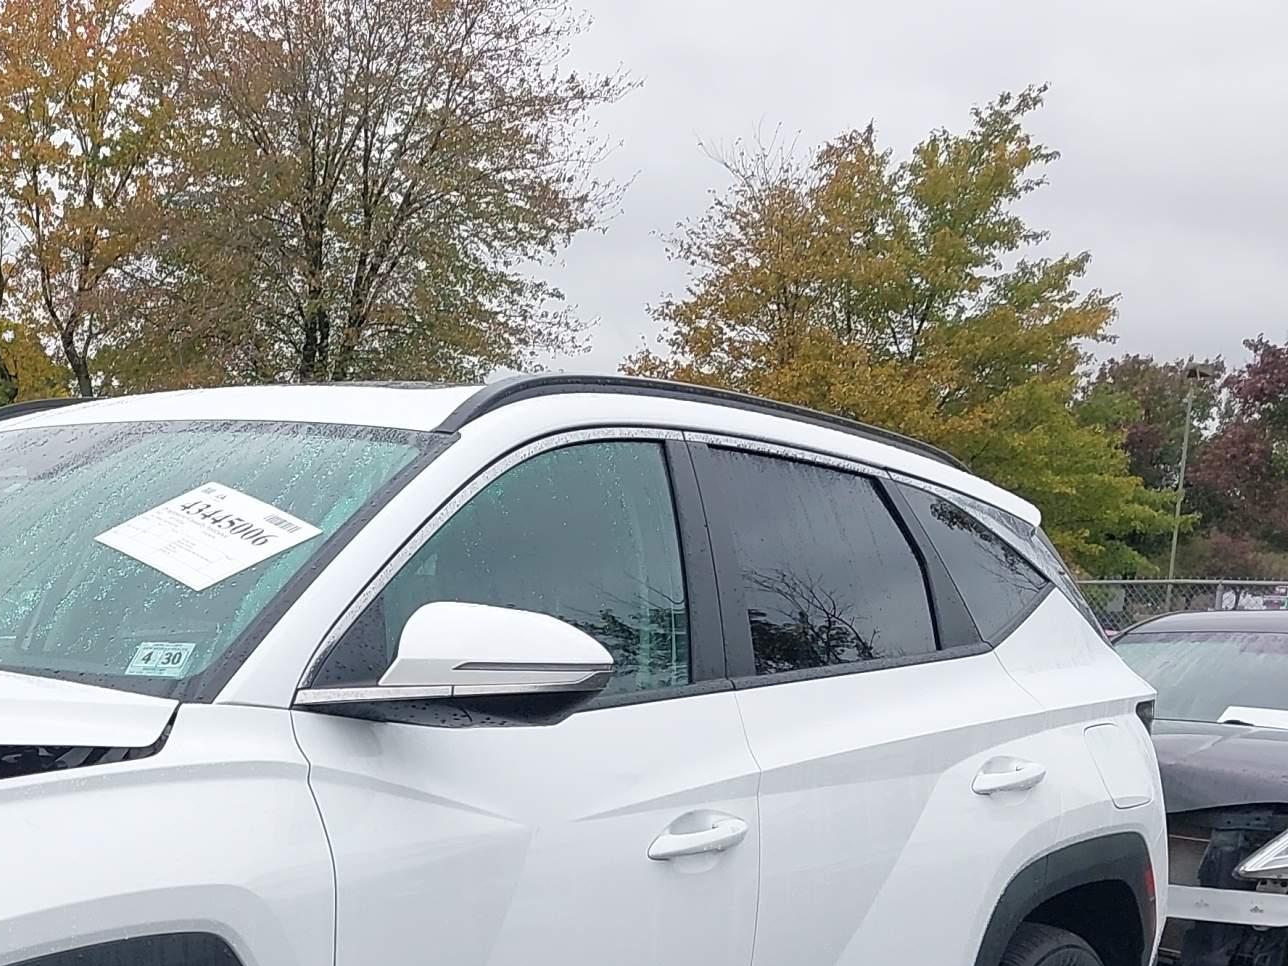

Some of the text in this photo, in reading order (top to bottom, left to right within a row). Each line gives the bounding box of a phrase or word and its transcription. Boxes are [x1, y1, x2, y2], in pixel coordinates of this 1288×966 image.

[180, 500, 279, 546] 43445006
[141, 651, 183, 665] 4 30
